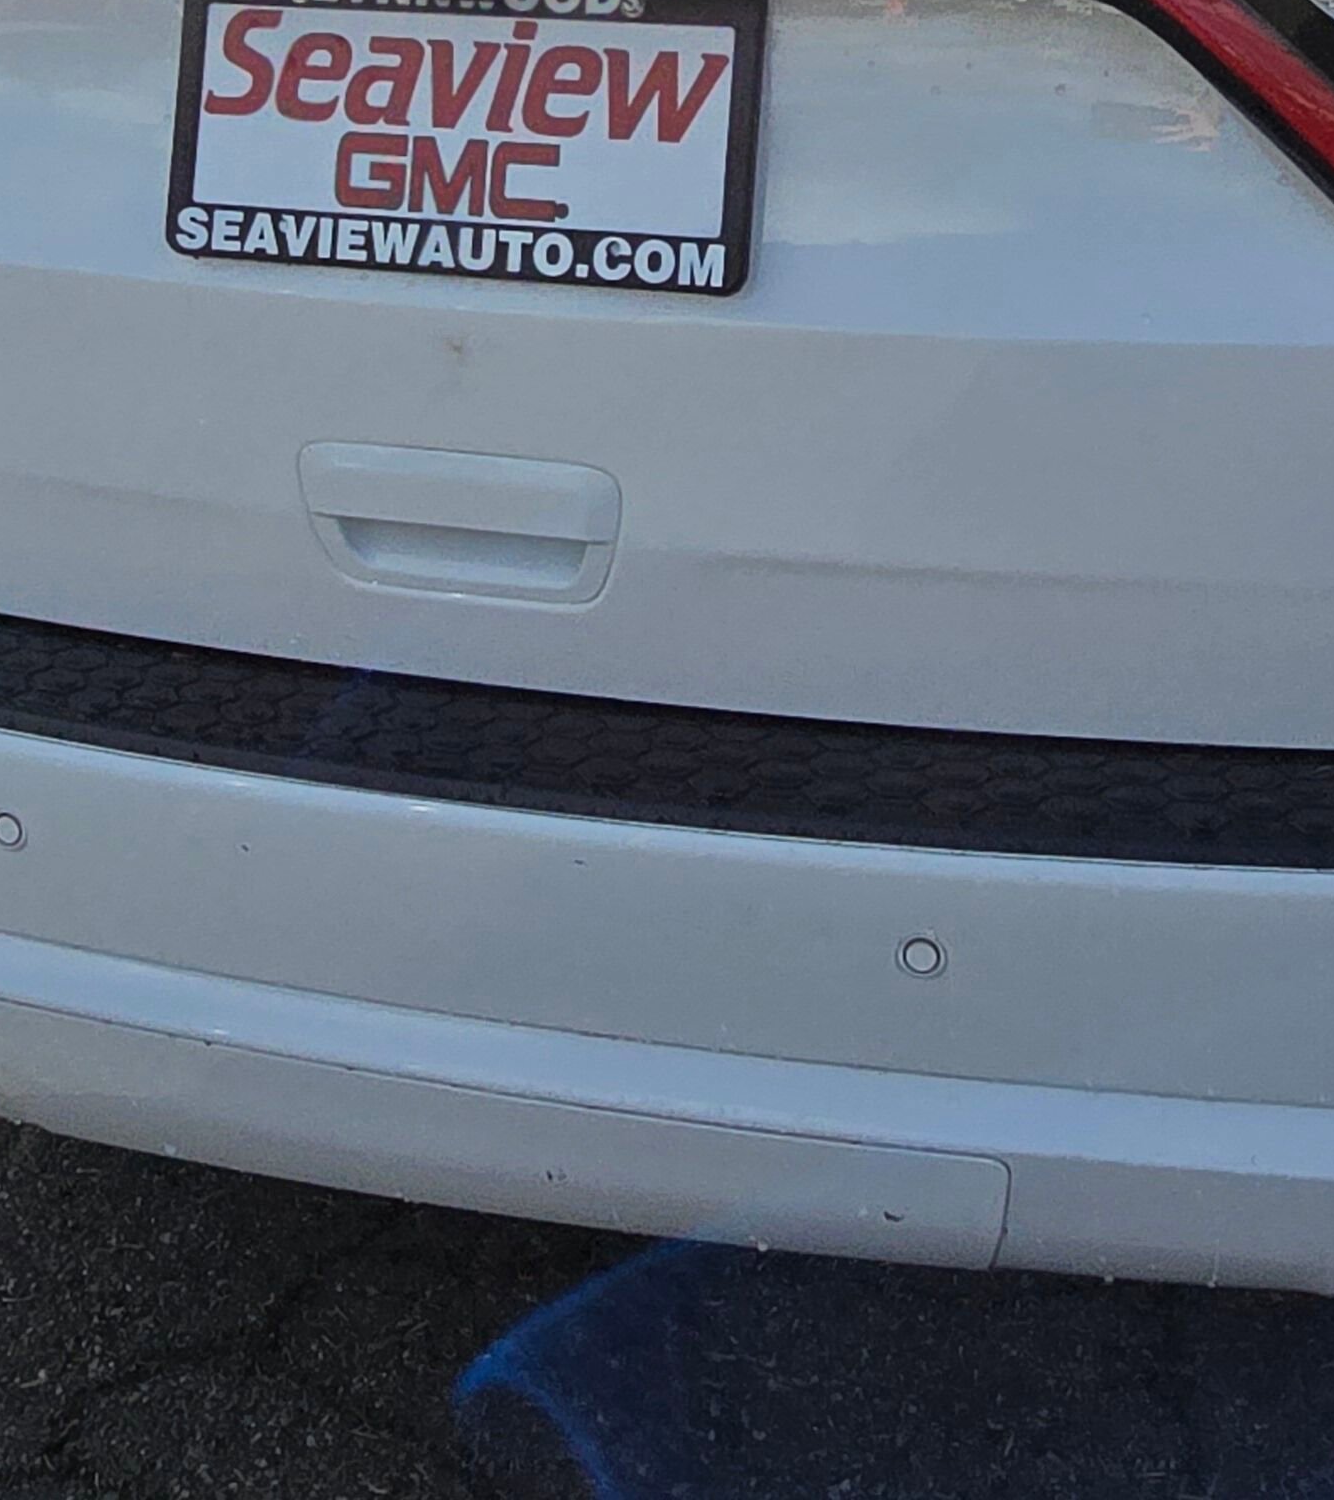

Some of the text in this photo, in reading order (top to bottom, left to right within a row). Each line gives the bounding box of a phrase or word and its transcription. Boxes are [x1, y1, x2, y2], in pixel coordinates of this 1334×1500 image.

[204, 8, 729, 143] Seaview
[334, 132, 561, 222] GMC
[175, 206, 725, 287] SEAVIEWAUTO.COM
